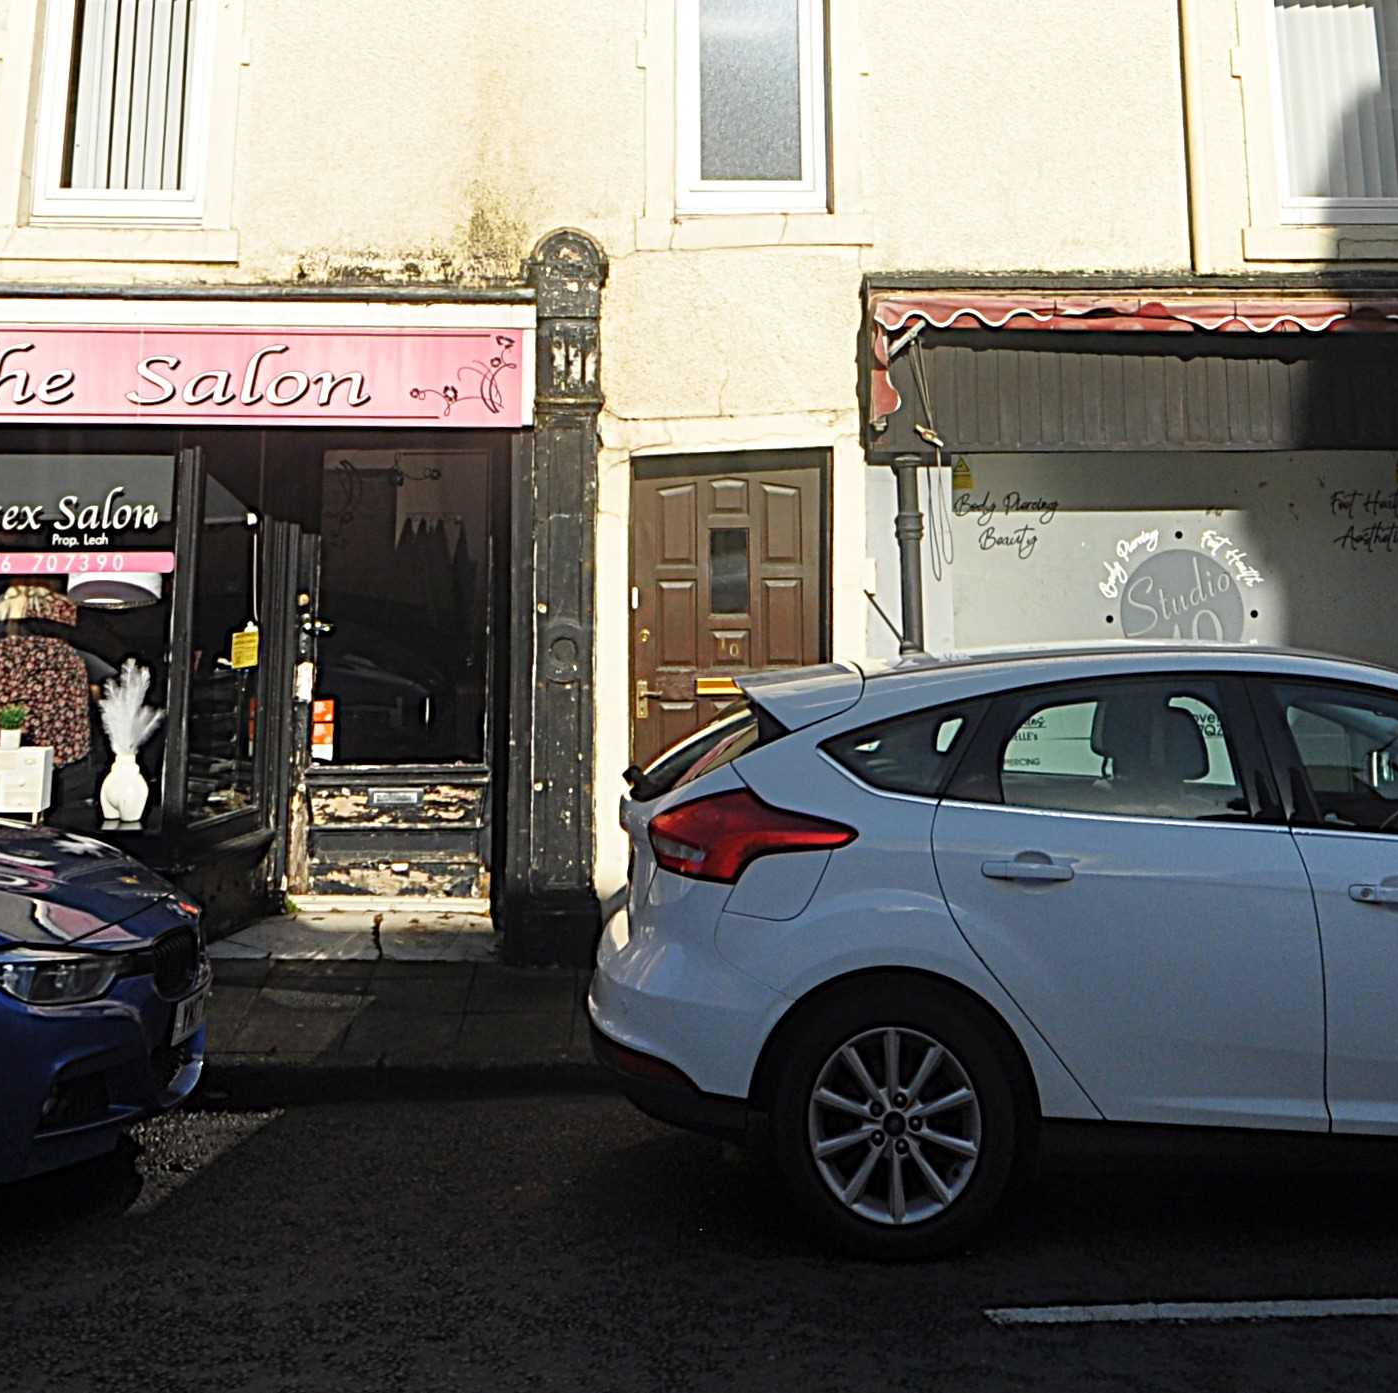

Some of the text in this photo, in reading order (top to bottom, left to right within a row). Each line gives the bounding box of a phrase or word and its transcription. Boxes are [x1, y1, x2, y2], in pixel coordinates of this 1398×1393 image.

[124, 344, 371, 407] Salon
[53, 486, 160, 532] Salon
[954, 491, 997, 526] Body
[52, 533, 109, 548] Prop. Leah
[979, 524, 1038, 559] Beauty
[32, 554, 125, 572] 707390
[1127, 556, 1231, 638] Studio
